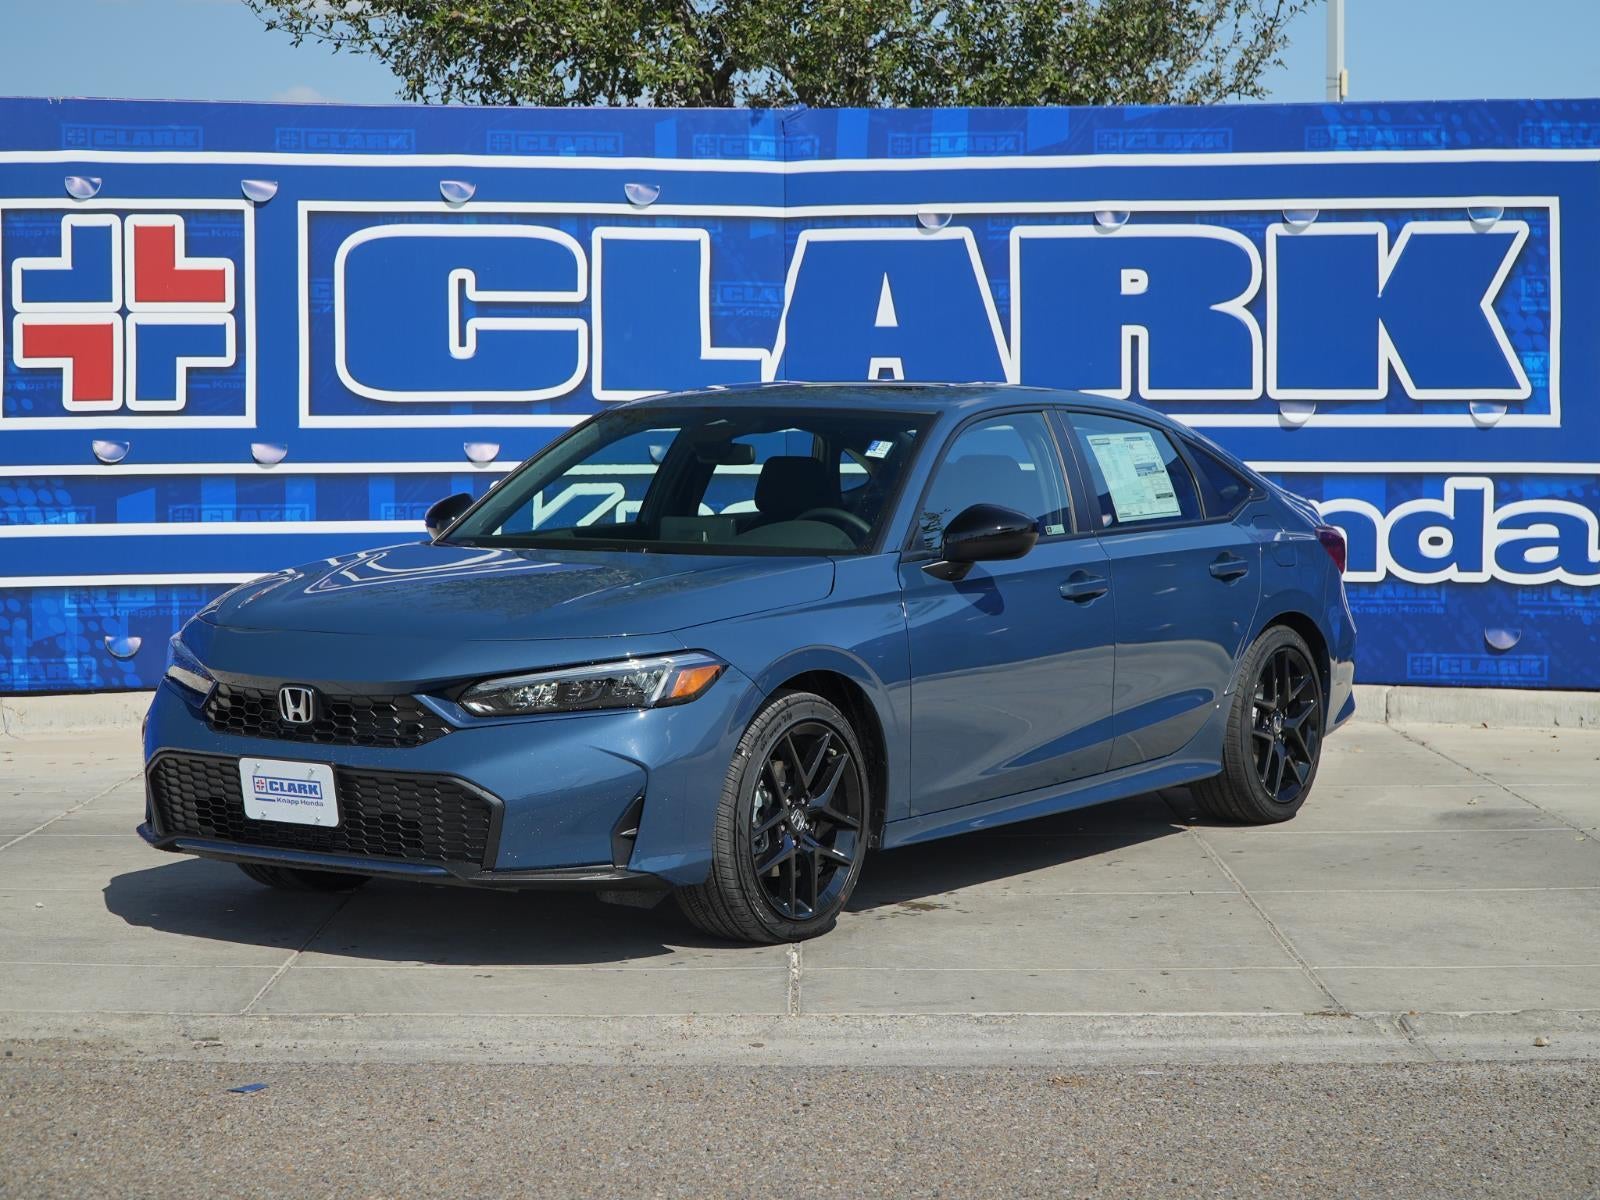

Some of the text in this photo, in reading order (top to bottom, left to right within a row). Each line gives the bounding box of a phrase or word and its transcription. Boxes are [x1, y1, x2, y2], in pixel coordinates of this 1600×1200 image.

[94, 130, 196, 146] CLARK
[307, 133, 409, 149] CLARK
[518, 136, 616, 152] CLARK
[918, 136, 1016, 153] CLARK
[1125, 133, 1226, 149] CLARK
[1337, 130, 1438, 146] CLARK
[723, 140, 812, 157] CLARK
[334, 221, 1532, 401] CLARK
[1308, 477, 1600, 584] nda
[1439, 659, 1541, 675] CLARK
[268, 780, 319, 796] CLARK
[276, 797, 324, 808] Knapp Honda
